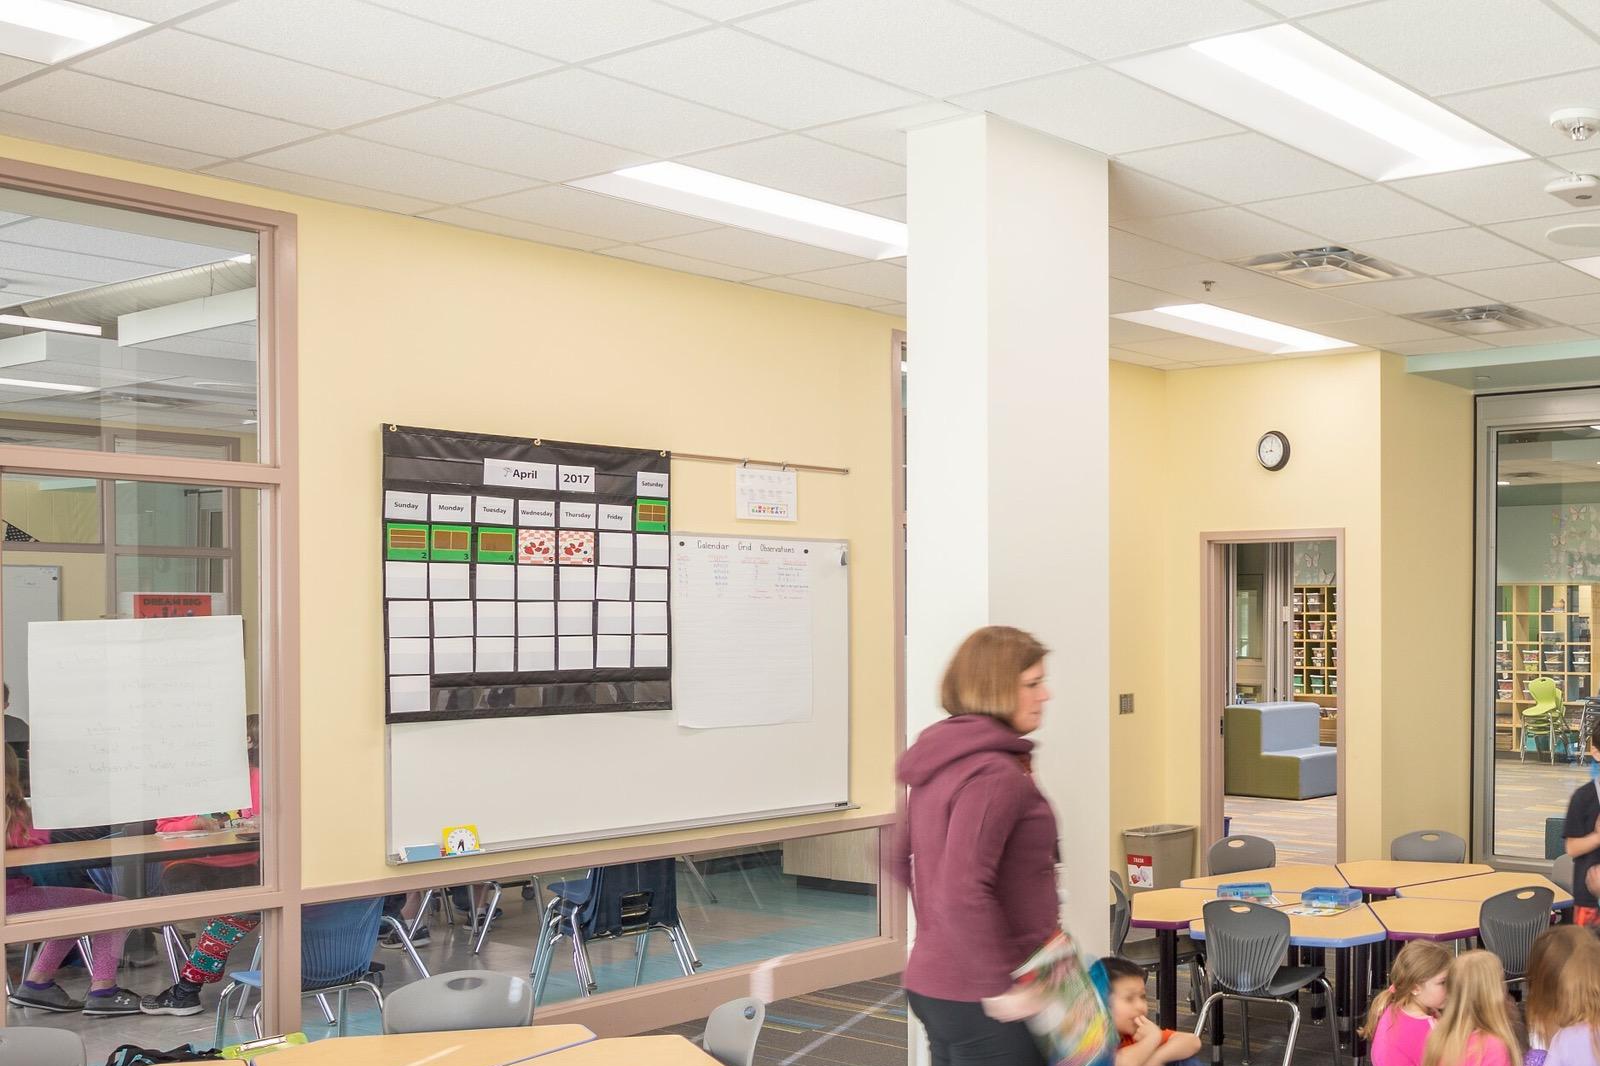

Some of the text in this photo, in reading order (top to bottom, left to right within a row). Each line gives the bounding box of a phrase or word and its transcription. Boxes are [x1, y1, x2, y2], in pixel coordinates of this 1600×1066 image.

[512, 469, 590, 484] April 2017
[697, 540, 795, 554] Calendar Grid Observations
